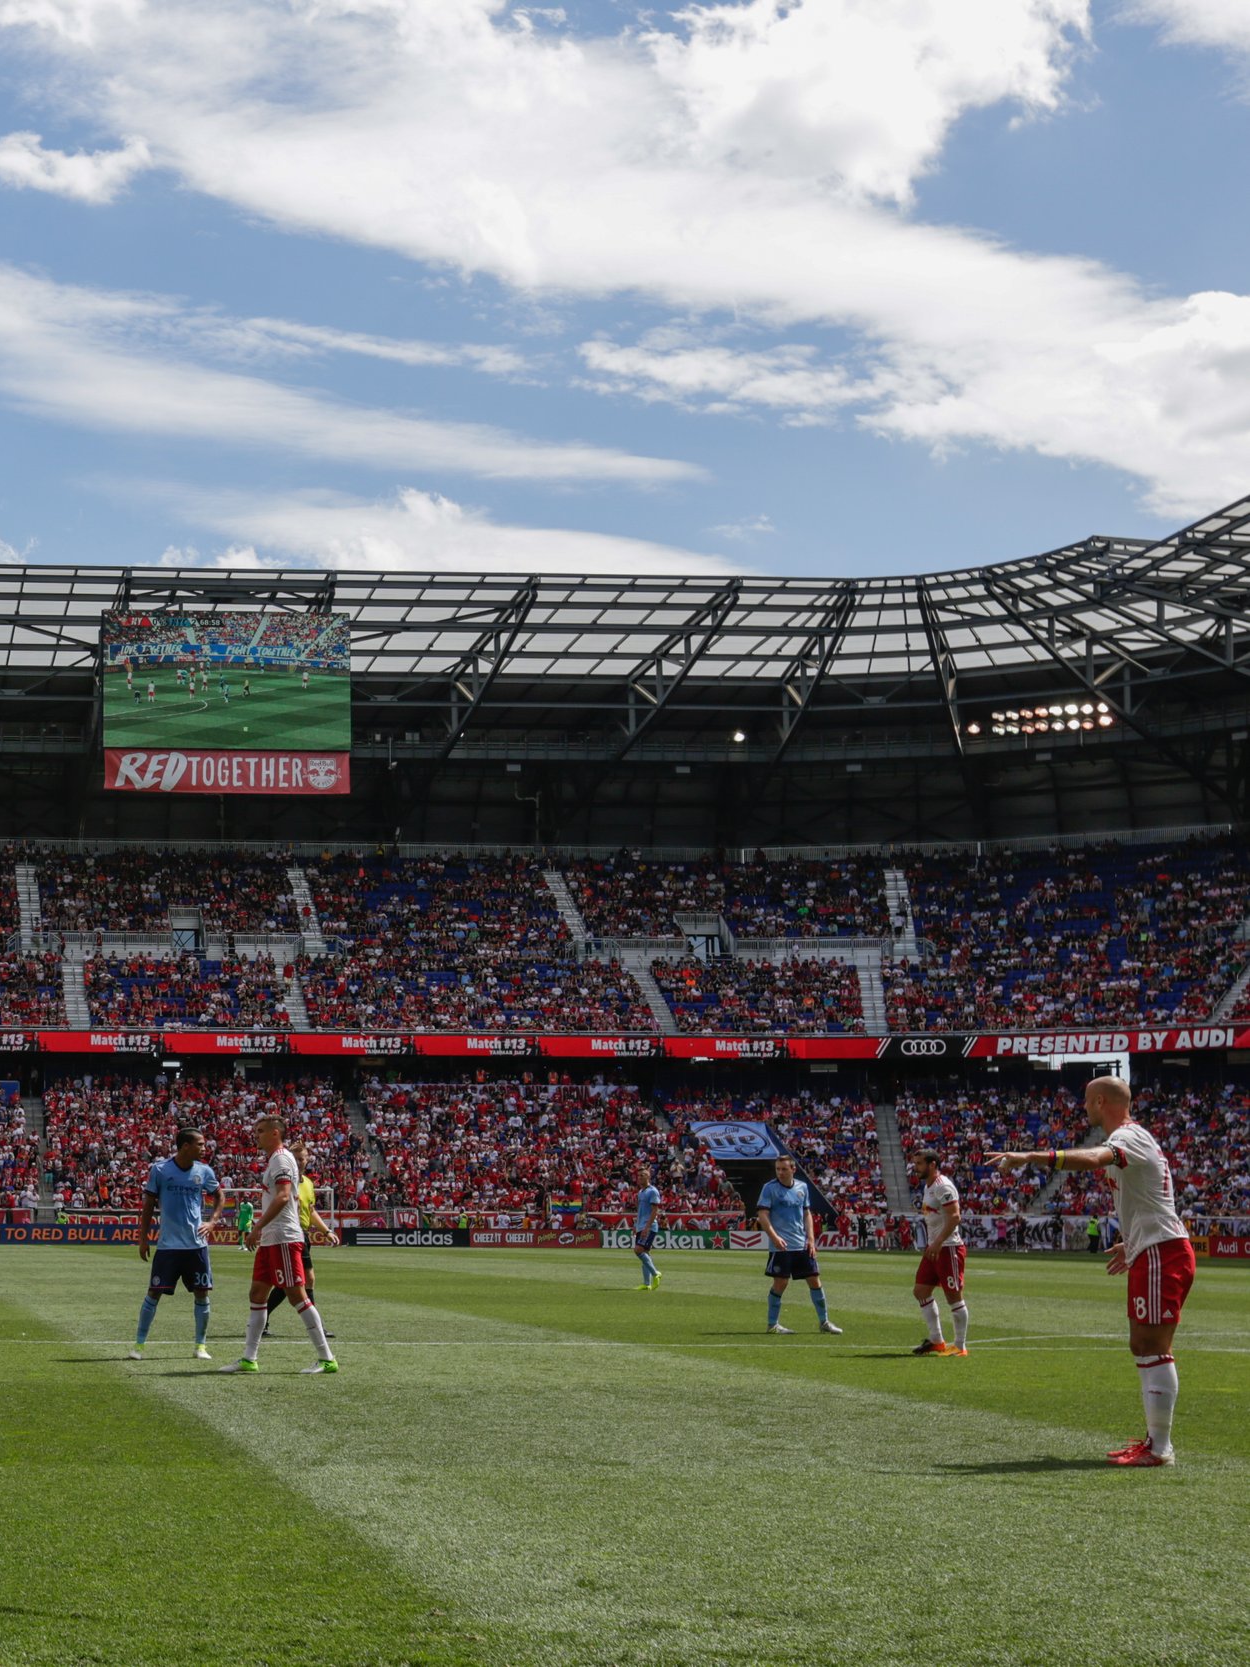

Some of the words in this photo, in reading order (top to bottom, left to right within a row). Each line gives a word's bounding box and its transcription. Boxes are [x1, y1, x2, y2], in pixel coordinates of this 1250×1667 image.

[142, 644, 183, 654] TGETHER
[114, 752, 187, 791] RED
[187, 755, 304, 788] TOGETHER
[2, 1034, 23, 1044] #13
[91, 1034, 125, 1045] Match
[128, 1035, 150, 1045] #13
[217, 1035, 251, 1046] Match
[254, 1036, 276, 1046] #13
[342, 1037, 376, 1047] Match
[379, 1038, 401, 1047] #13
[467, 1038, 501, 1048] Match
[504, 1038, 525, 1048] #13
[592, 1039, 625, 1049] Match
[628, 1040, 650, 1050] #13
[996, 1031, 1132, 1055] PRESENTED
[1137, 1030, 1168, 1051] BY
[1175, 1028, 1234, 1049] AUDI
[716, 1040, 750, 1051] Match
[753, 1041, 774, 1051] #13
[5, 1227, 27, 1240] TO
[31, 1228, 63, 1240] RED
[67, 1228, 108, 1241] BULL
[394, 1230, 454, 1245] adidas
[602, 1230, 706, 1249] Heieken
[1217, 1241, 1238, 1253] Audi
[195, 1273, 209, 1287] 30
[947, 1276, 956, 1289] 8
[1134, 1296, 1147, 1320] 8
